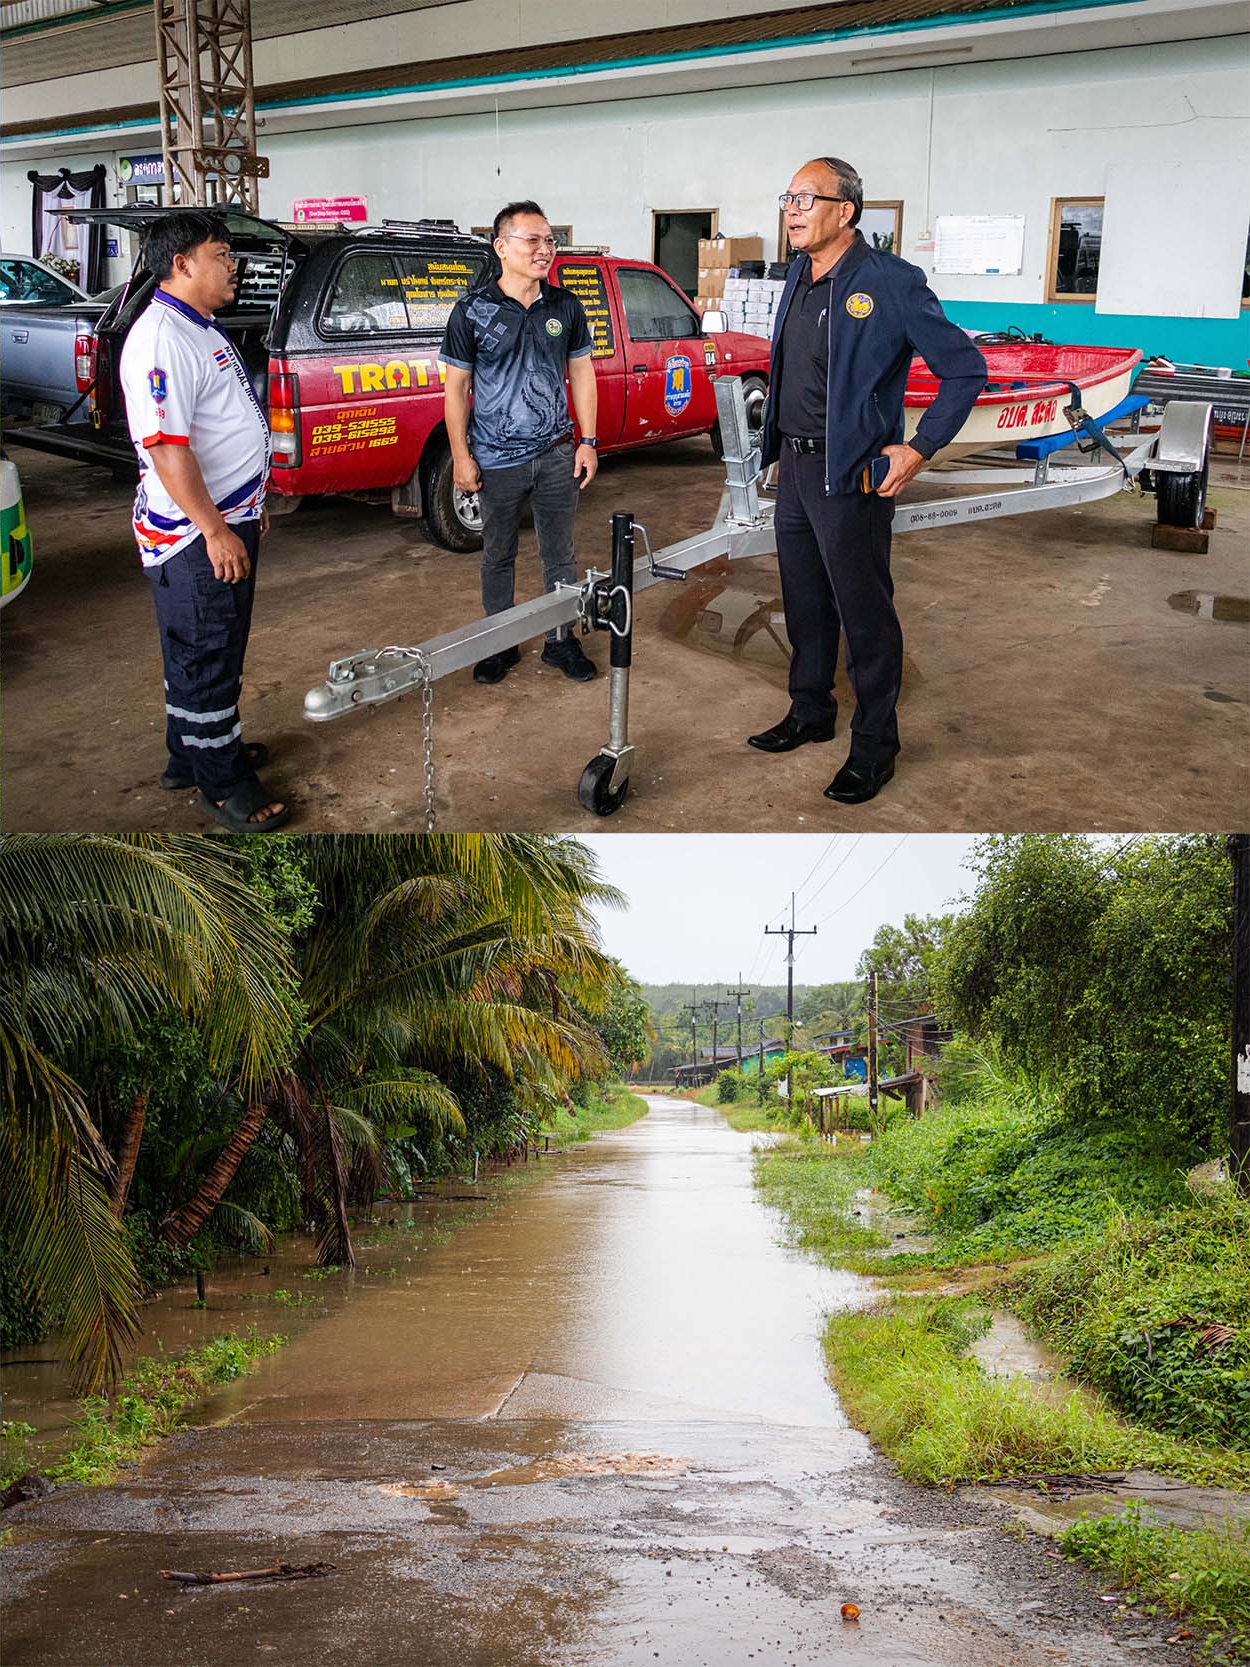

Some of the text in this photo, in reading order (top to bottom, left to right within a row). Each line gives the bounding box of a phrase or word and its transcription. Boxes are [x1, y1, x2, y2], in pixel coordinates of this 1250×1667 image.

[224, 346, 245, 387] NATIONAL
[333, 359, 432, 395] TRAT
[312, 416, 396, 436] 039-531555
[997, 400, 1058, 429] อบต. สะตอ
[310, 436, 398, 457] สายด่วน 1669
[312, 425, 396, 445] 039-615292
